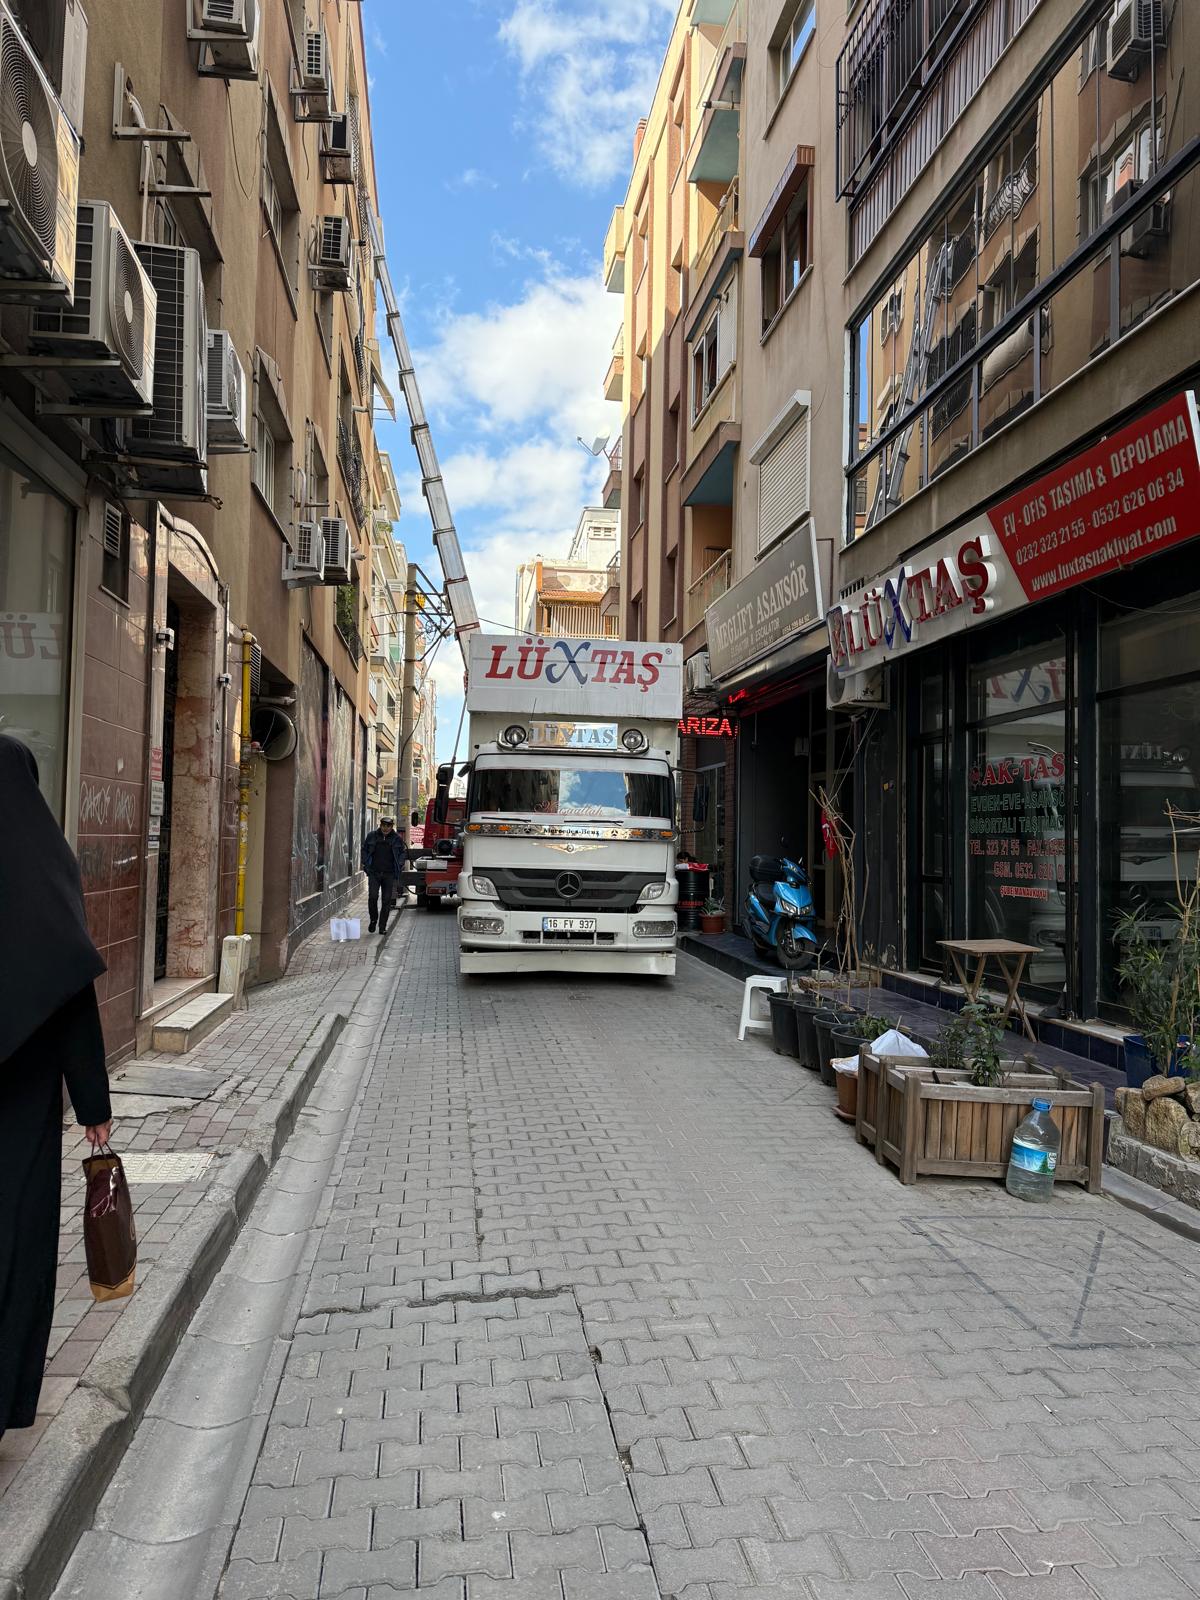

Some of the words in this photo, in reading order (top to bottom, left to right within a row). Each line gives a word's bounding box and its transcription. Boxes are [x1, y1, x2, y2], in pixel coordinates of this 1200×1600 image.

[1003, 512, 1016, 537] EV
[1023, 495, 1047, 526] OFİS
[1050, 468, 1095, 511] TAŞIMA
[1097, 466, 1107, 486] &
[1110, 415, 1188, 478] DEPOLAMA
[1016, 542, 1039, 565] 0232
[1040, 535, 1058, 558] 323
[1060, 527, 1070, 545] 21
[1072, 519, 1085, 539] 55
[1092, 501, 1121, 528] 0532
[1123, 488, 1146, 513] 626
[1147, 479, 1165, 502] 06
[1167, 467, 1185, 493] 34
[844, 535, 997, 656] LÜXTAŞ
[1031, 516, 1177, 592] www.luxtasnakliyat.com
[716, 602, 754, 650] MEGLİFT
[756, 560, 809, 625] ASANSÖR
[485, 638, 664, 693] LÜXTAŞ
[677, 717, 733, 736] ARIZA
[548, 919, 558, 929] 16
[579, 919, 594, 929] 937
